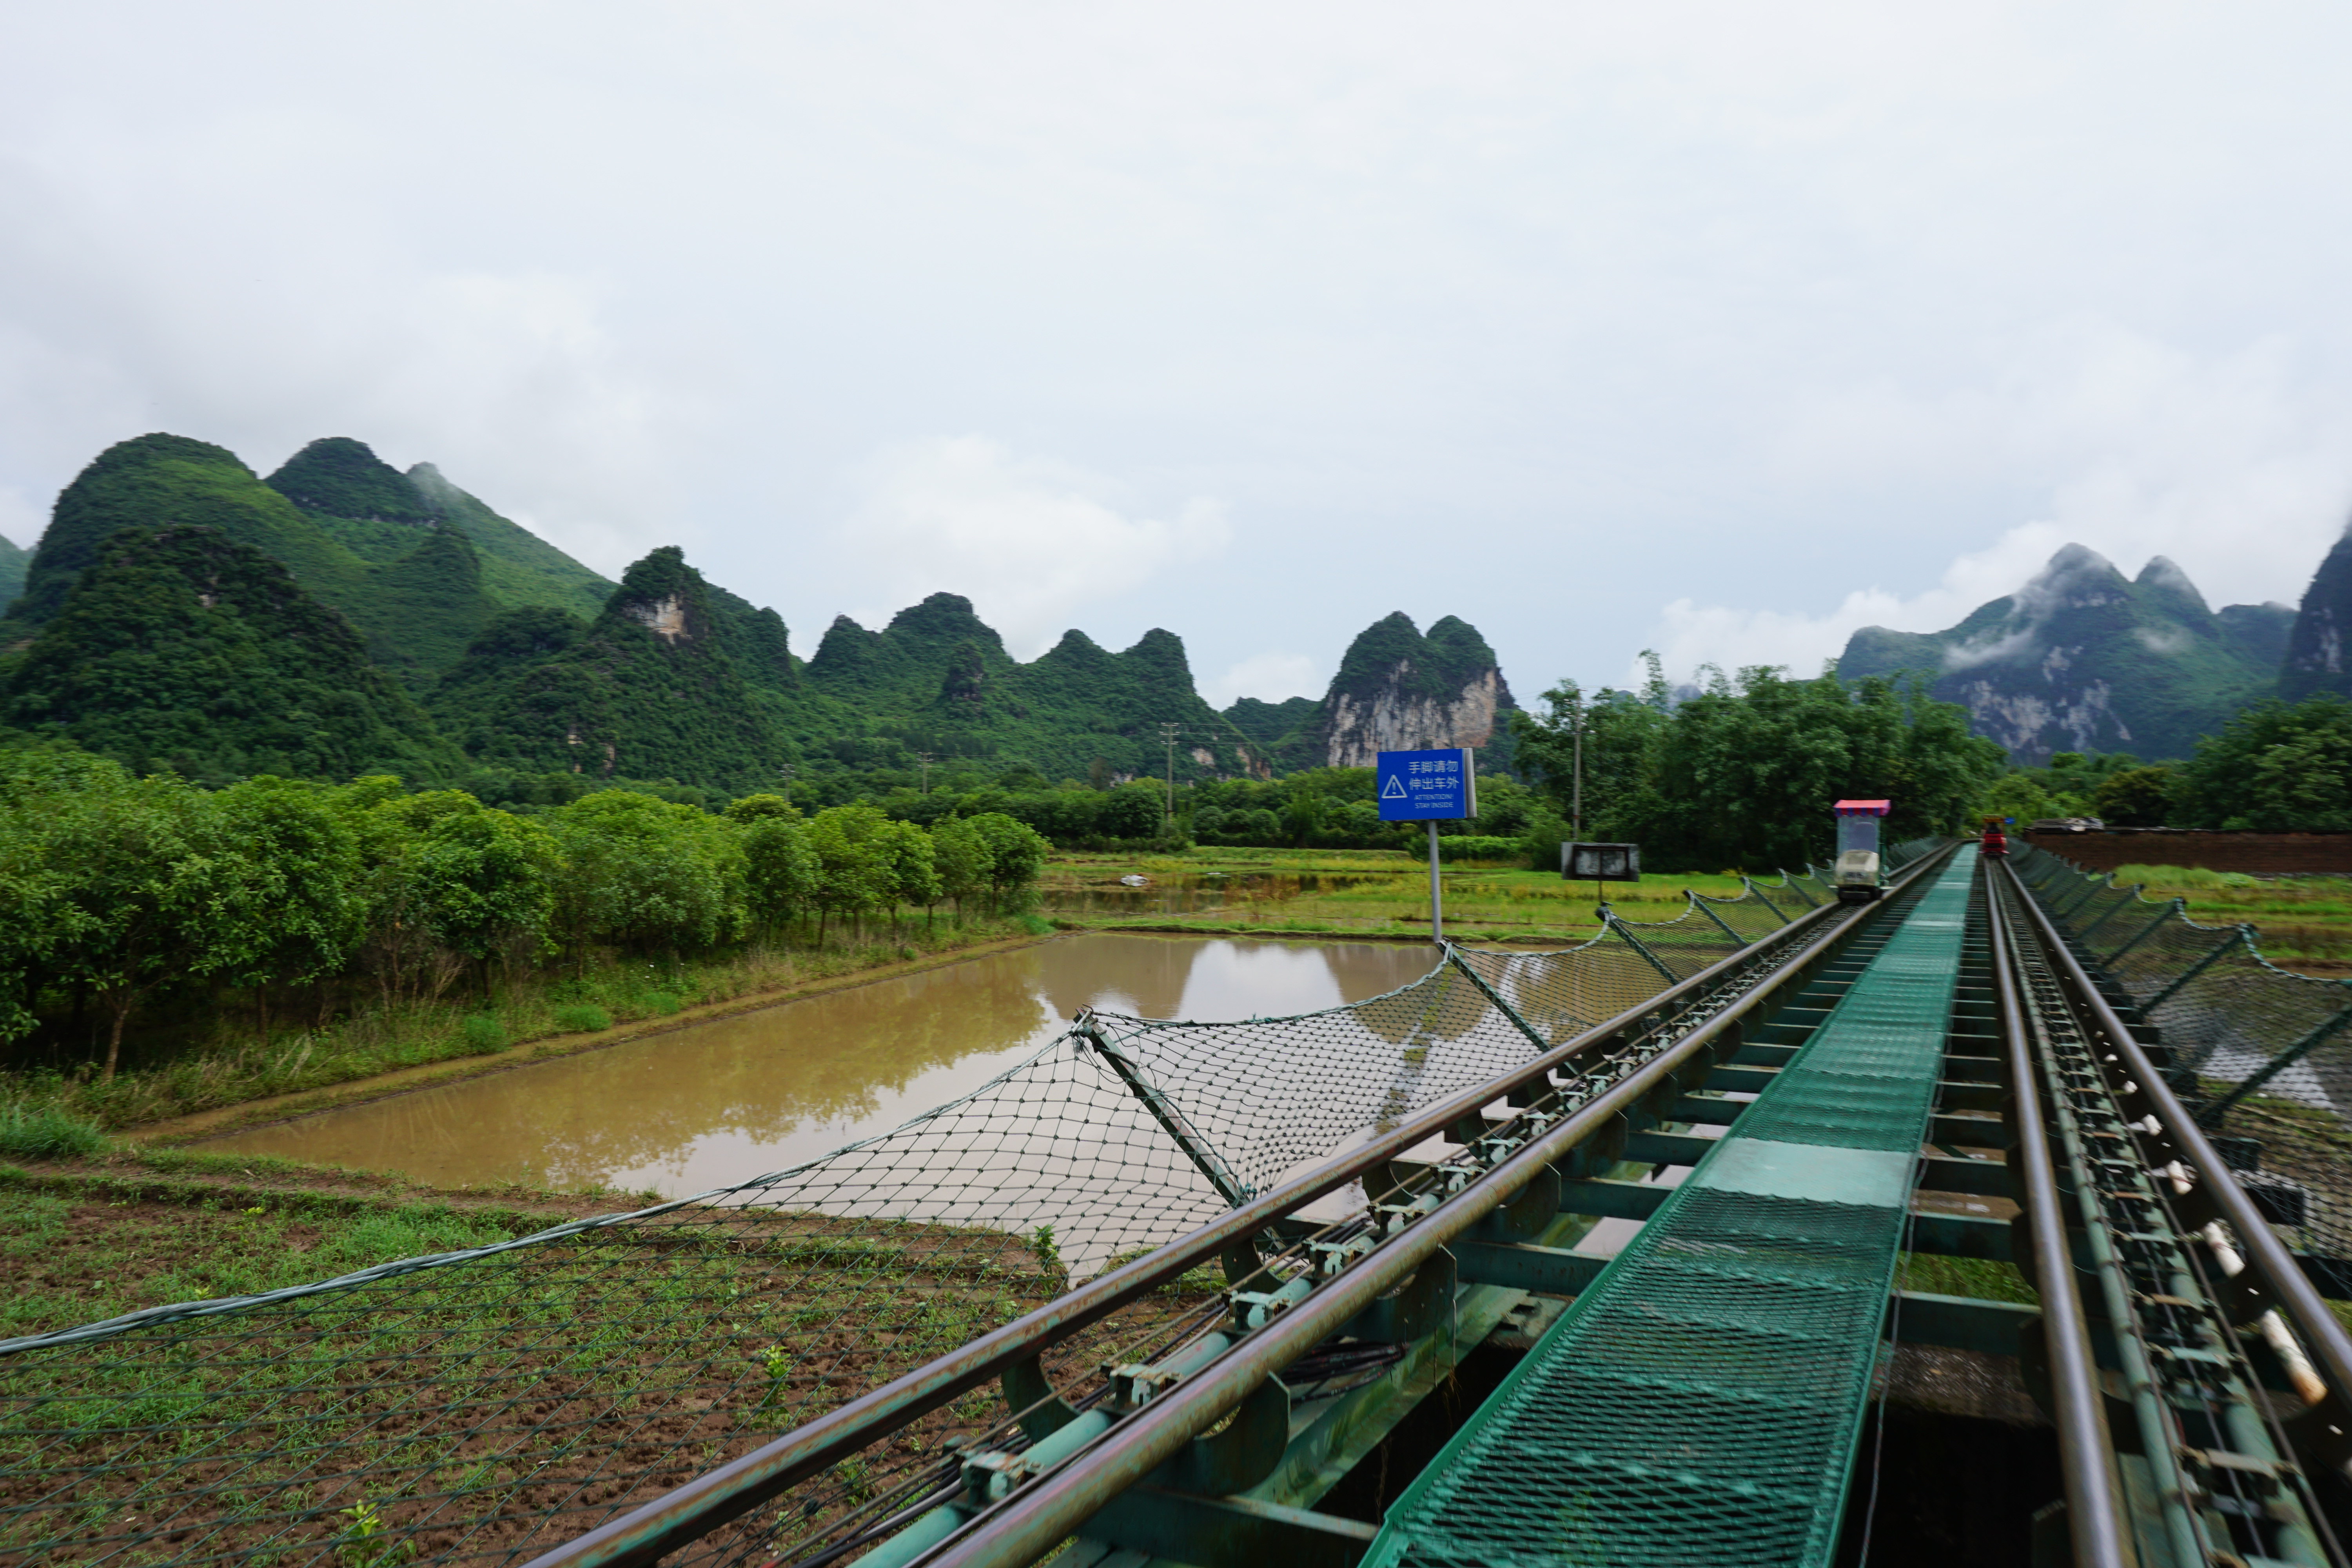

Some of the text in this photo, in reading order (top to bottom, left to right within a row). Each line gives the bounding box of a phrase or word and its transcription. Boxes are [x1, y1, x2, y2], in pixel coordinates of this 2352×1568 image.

[1408, 760, 1458, 773] 手脚请勿
[1408, 776, 1459, 790] 伸出车外
